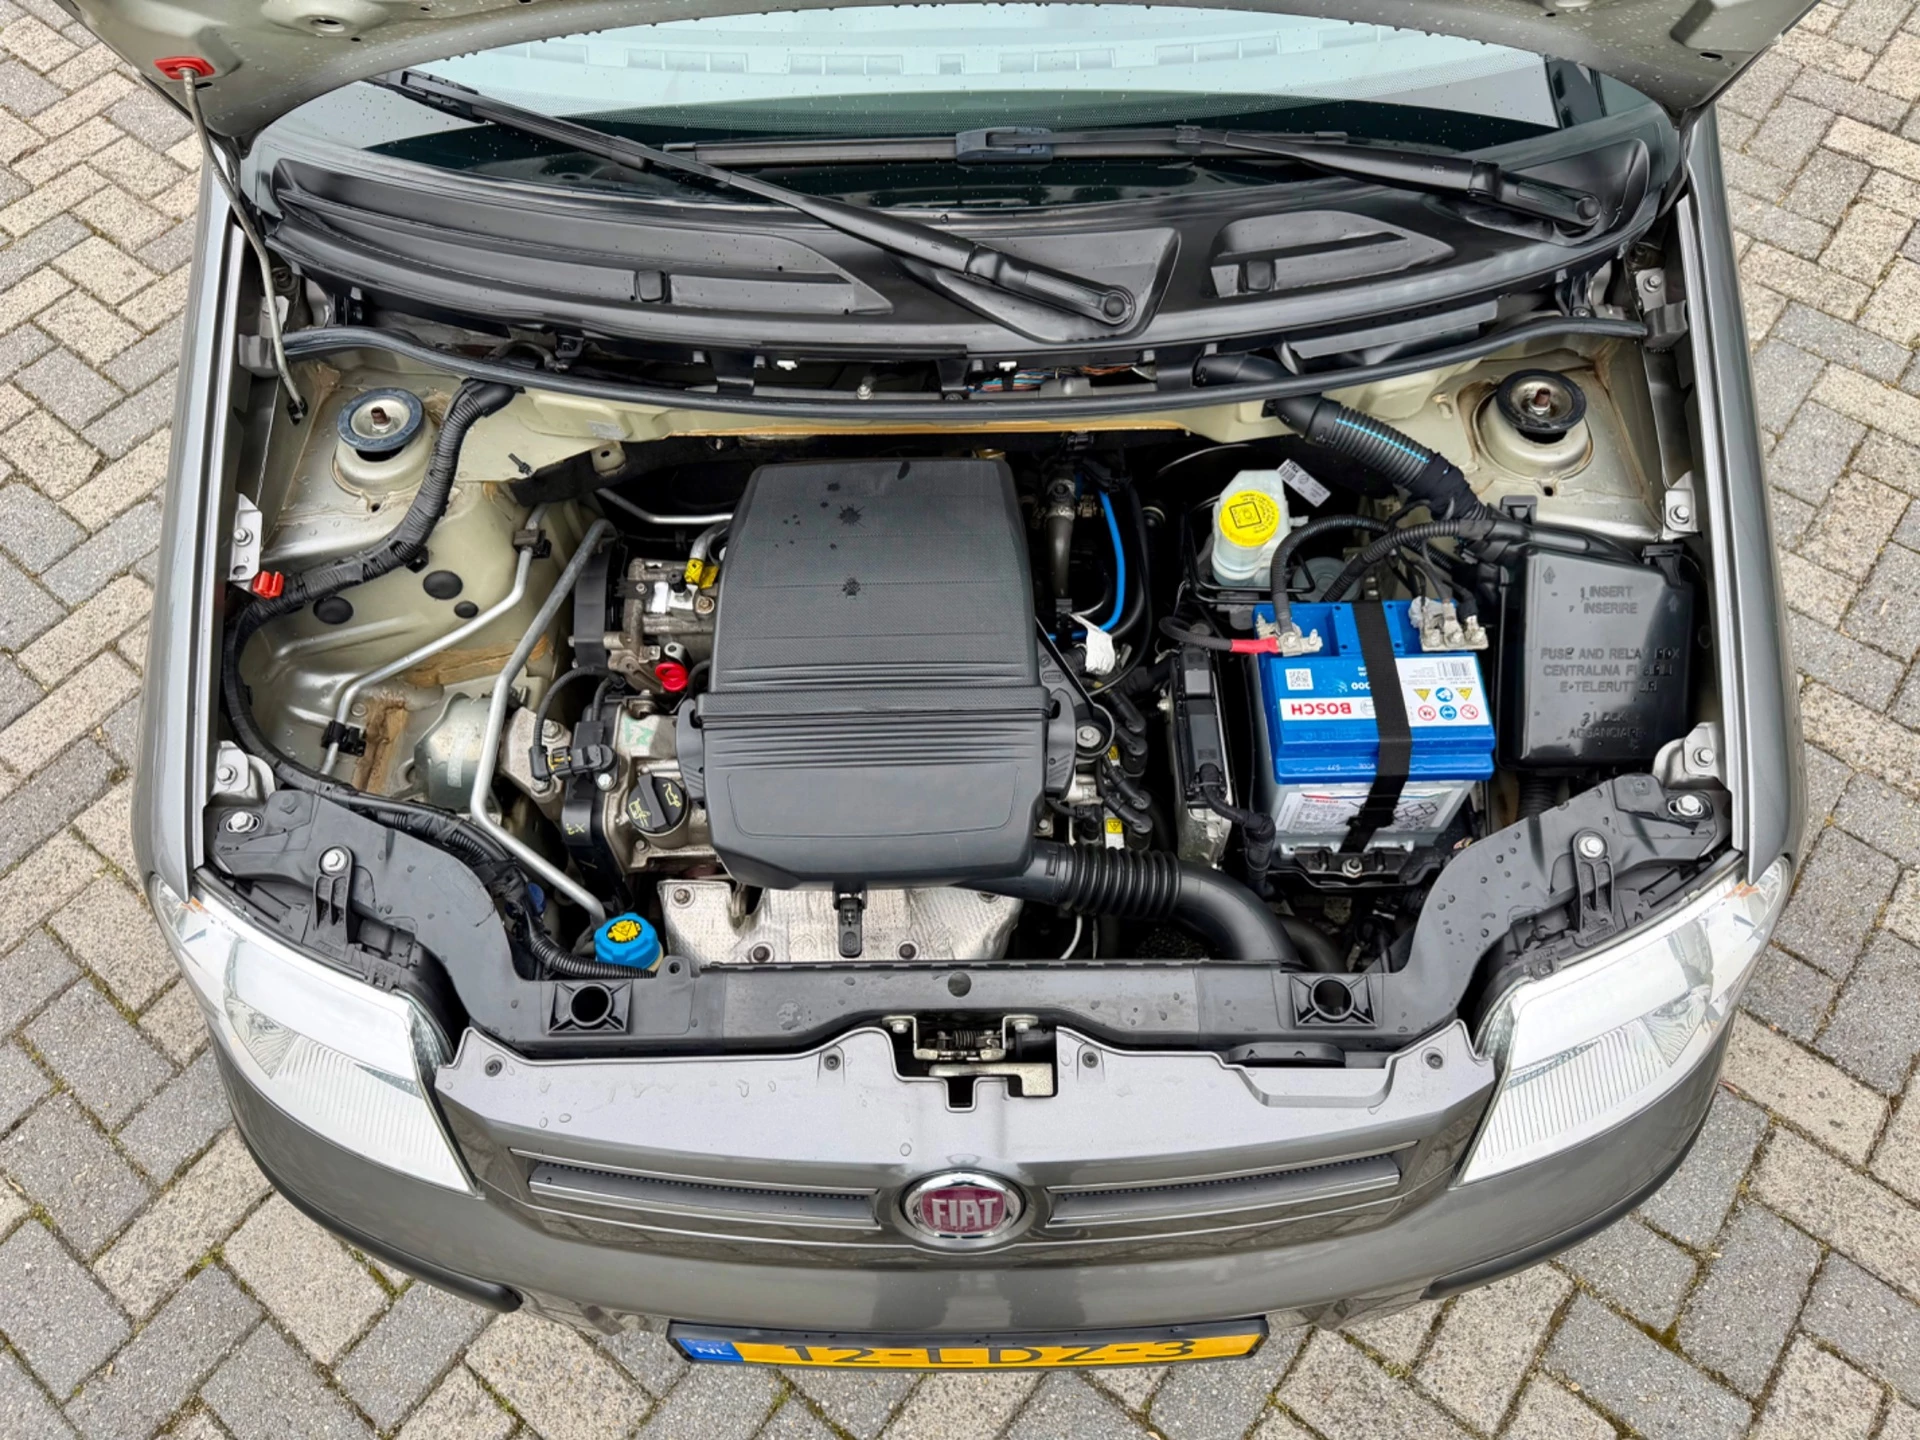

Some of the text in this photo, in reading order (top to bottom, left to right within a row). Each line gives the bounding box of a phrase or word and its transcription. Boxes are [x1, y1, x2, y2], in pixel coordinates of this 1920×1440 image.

[1589, 585, 1634, 598] INSERT
[1583, 602, 1638, 614] INSERIRE
[1540, 648, 1573, 660] FUSE
[1578, 648, 1604, 660] AND
[1543, 665, 1620, 677] CENTRALINA
[1290, 702, 1352, 715] BOSCH
[931, 1197, 999, 1229] FIAT
[697, 1339, 1197, 1365] NL 12-LDZ-3
